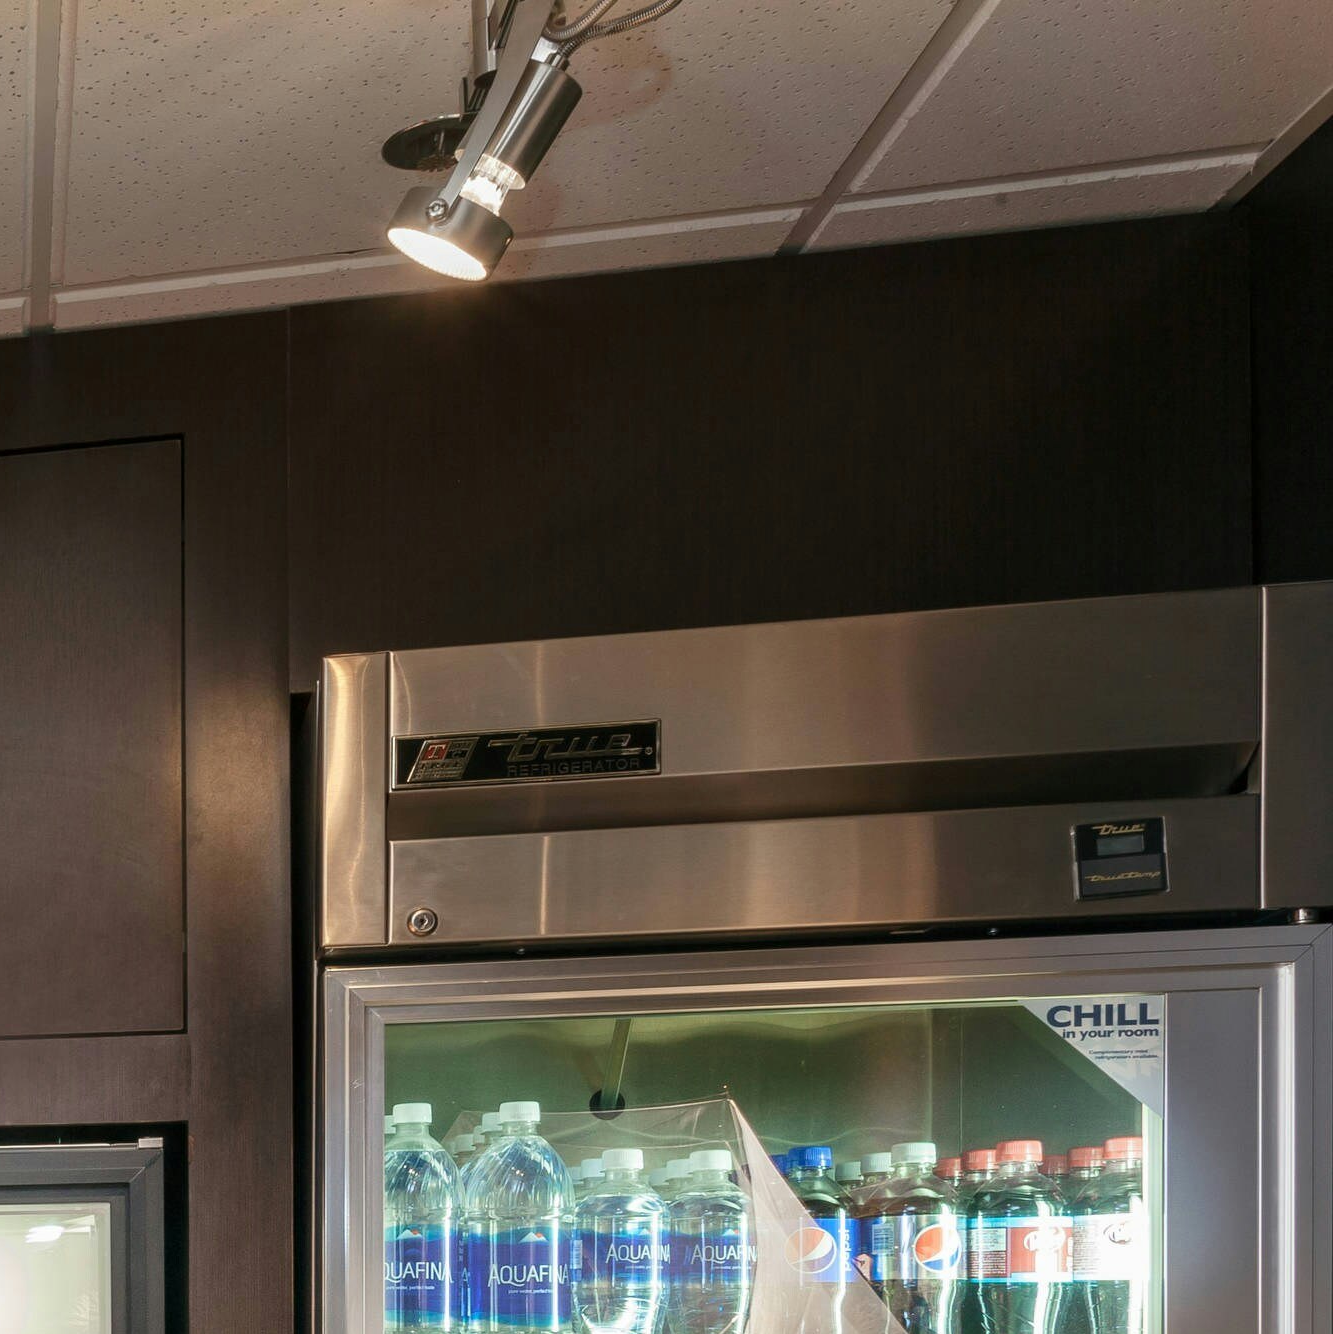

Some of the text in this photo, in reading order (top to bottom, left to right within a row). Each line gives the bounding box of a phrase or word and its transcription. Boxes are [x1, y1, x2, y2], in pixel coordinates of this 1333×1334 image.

[507, 758, 640, 777] REFRIGERATOR
[1046, 1003, 1160, 1028] CHILL
[1063, 1028, 1159, 1041] in your room
[487, 1263, 570, 1288] AQUAFINA
